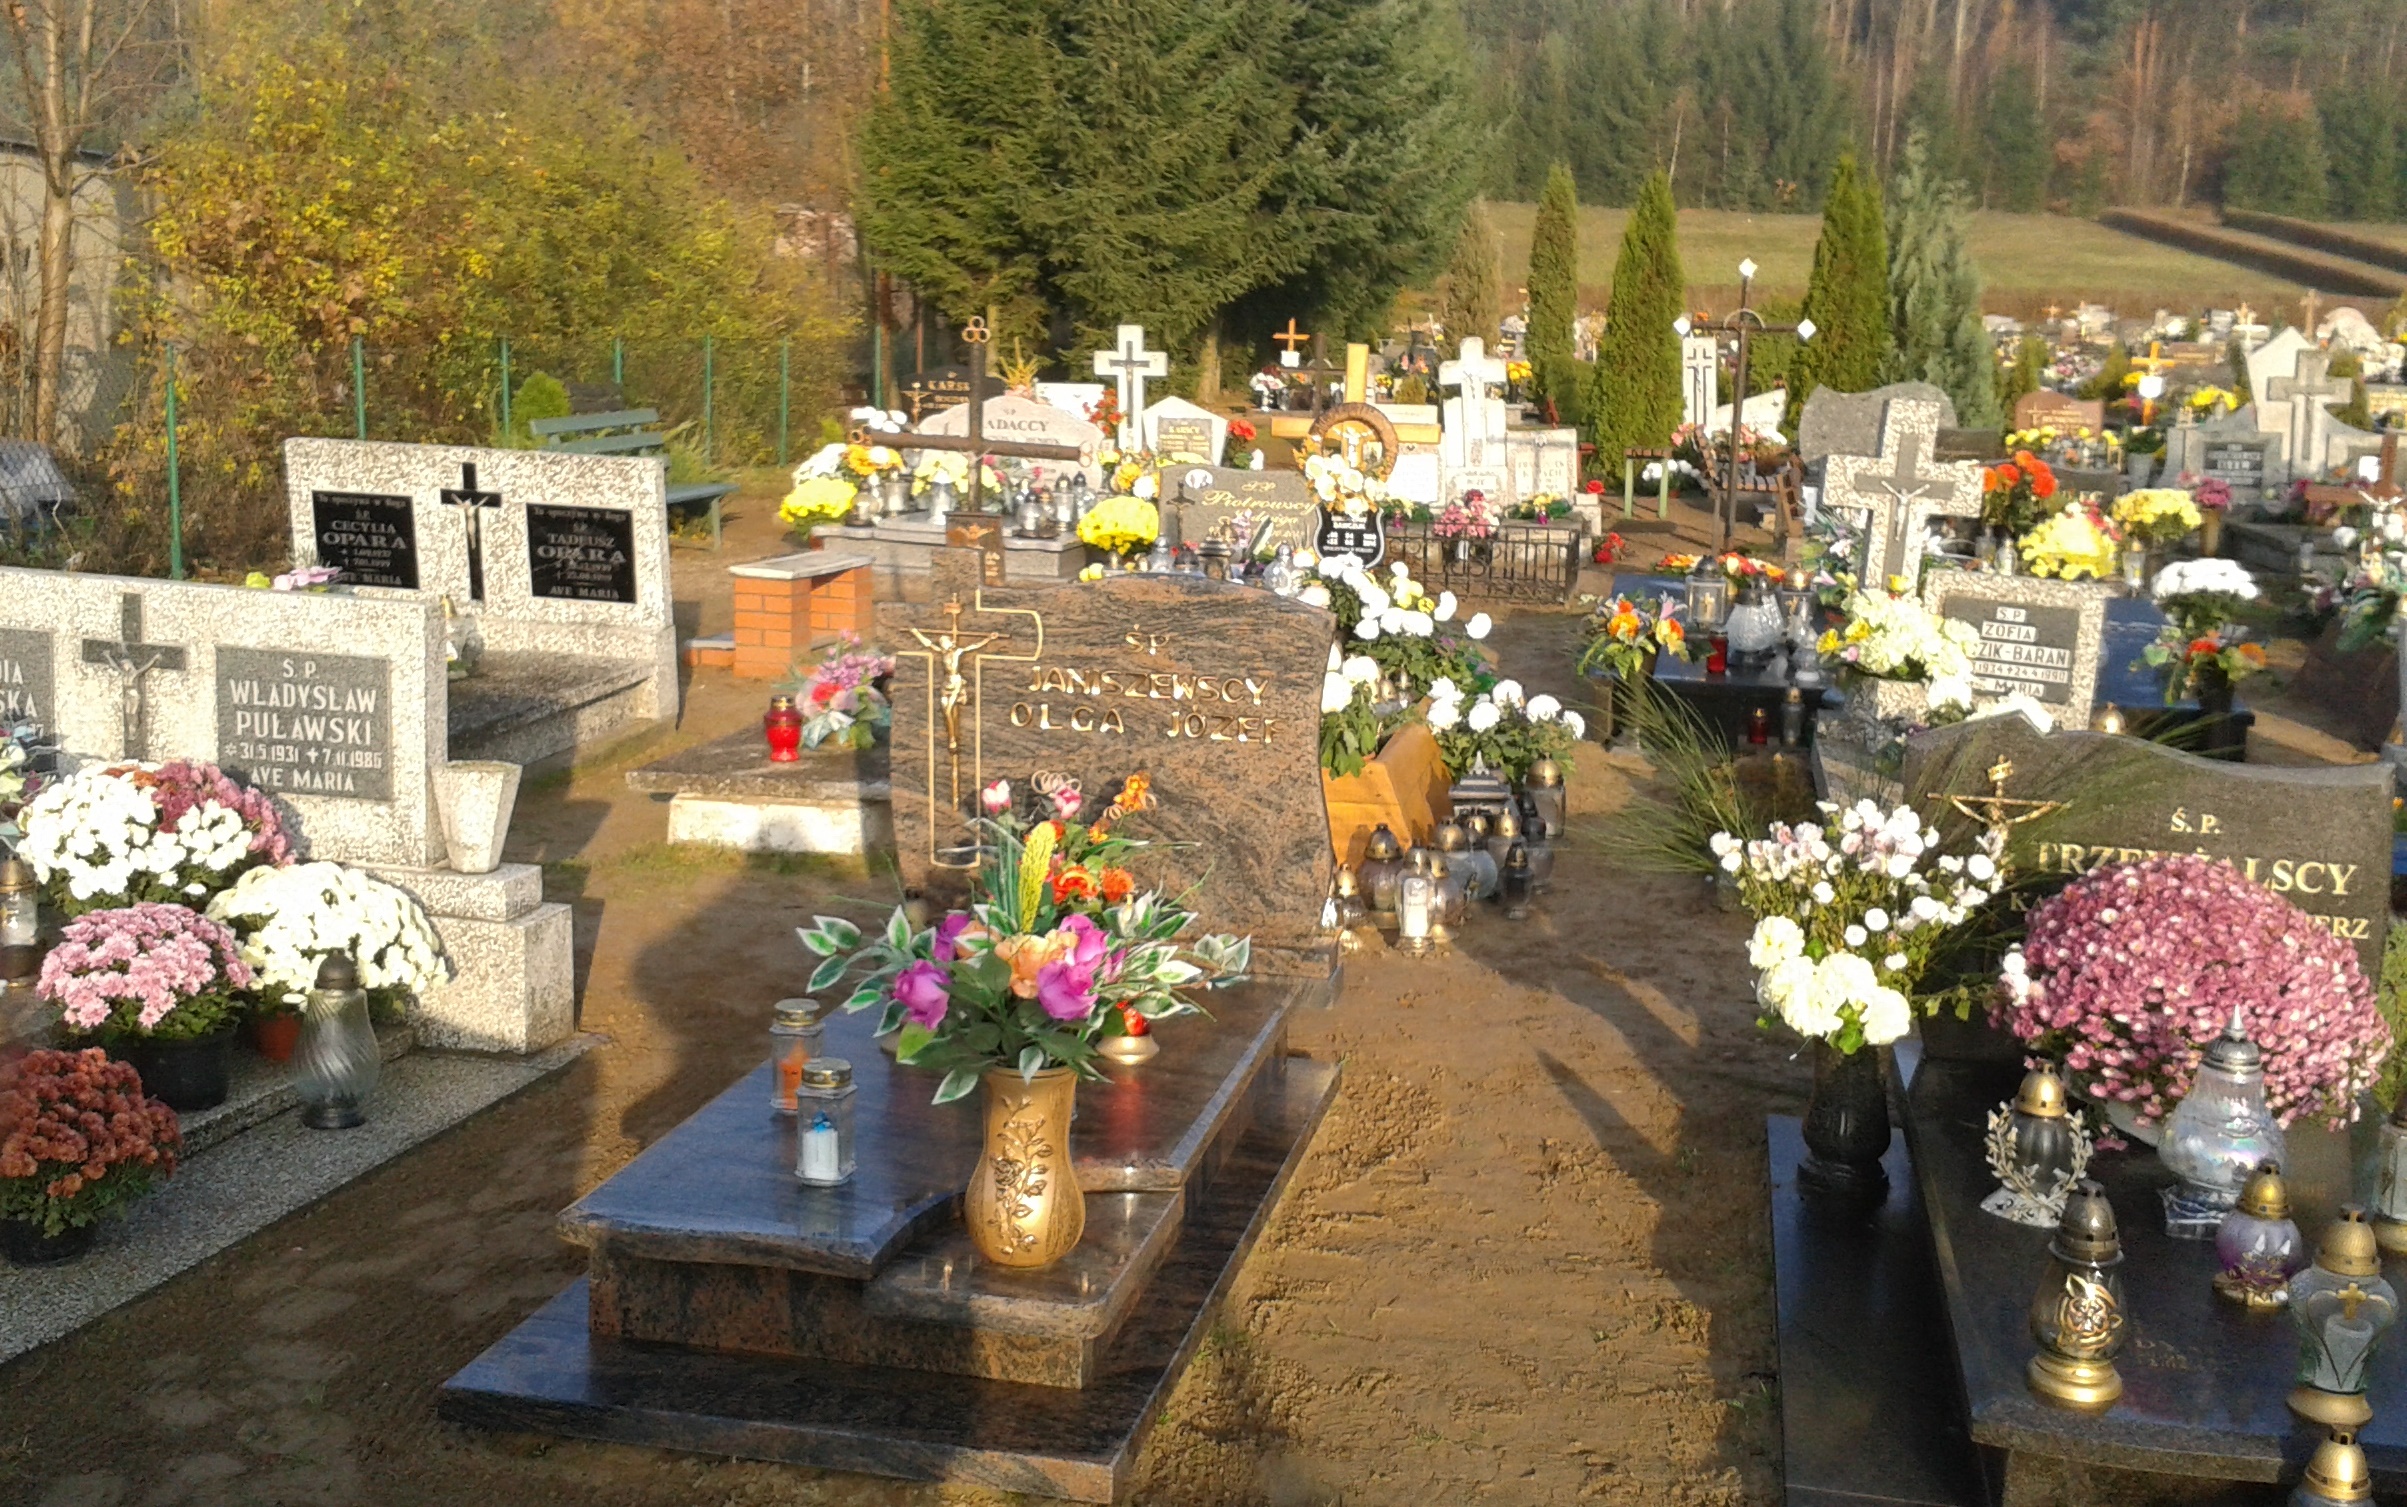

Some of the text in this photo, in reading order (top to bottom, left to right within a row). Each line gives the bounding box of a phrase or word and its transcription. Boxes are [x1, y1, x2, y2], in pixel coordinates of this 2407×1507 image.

[331, 520, 397, 534] CECYLIA
[322, 531, 407, 550] OPARA
[547, 533, 615, 549] TADEUSZ
[537, 546, 627, 563] OPARA
[362, 573, 402, 585] MARIA
[550, 586, 620, 600] AVE MARIA
[1985, 623, 2032, 640] ZOFIA
[1028, 665, 1269, 706] JANISZEWSCY
[1994, 679, 2042, 696] MARIA
[1009, 701, 1285, 744] OLGA JÓZEF
[251, 765, 355, 792] AVE MARIA
